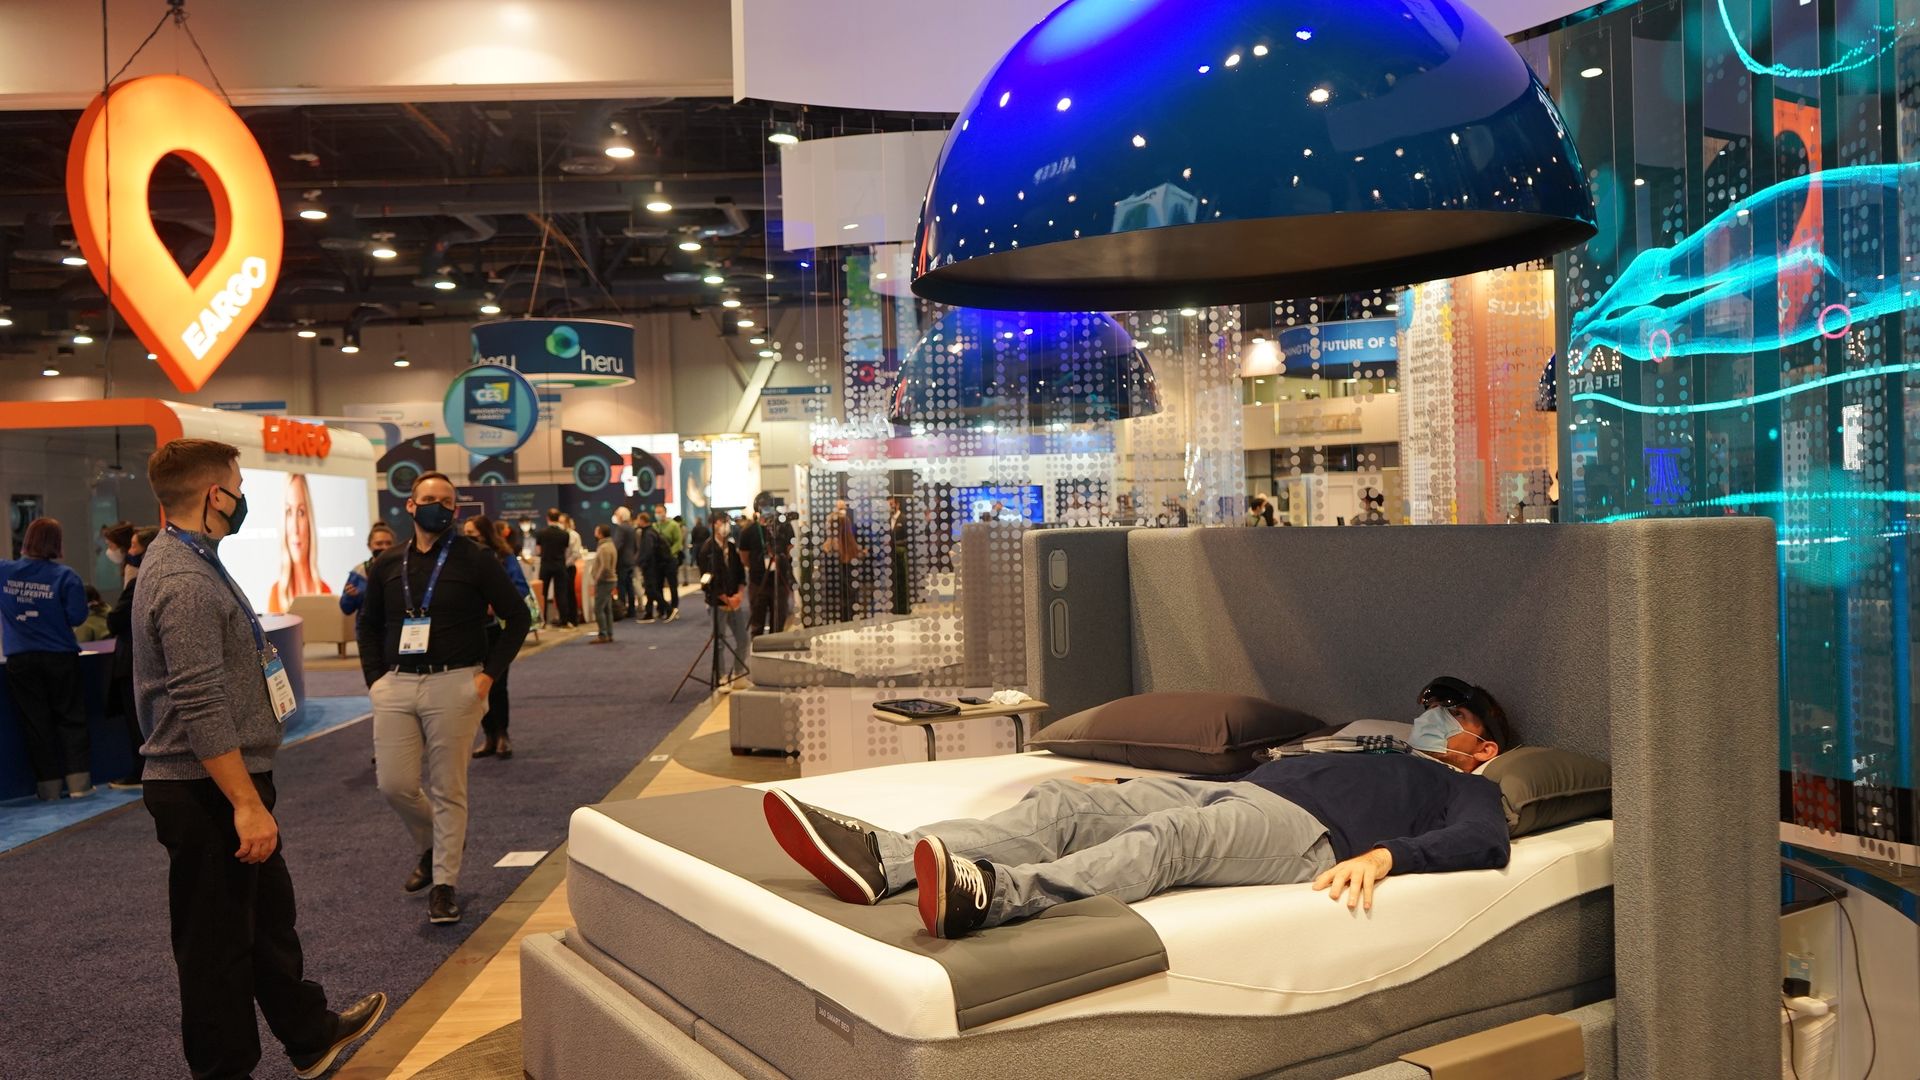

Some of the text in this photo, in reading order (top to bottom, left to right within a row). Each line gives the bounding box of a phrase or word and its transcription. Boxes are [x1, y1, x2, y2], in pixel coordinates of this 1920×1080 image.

[182, 256, 267, 360] EARGO
[1321, 338, 1365, 352] FUTURE
[1367, 336, 1386, 349] OF
[580, 349, 624, 374] heru
[476, 388, 501, 402] CES
[263, 415, 331, 459] EARGO
[479, 431, 503, 440] 2022
